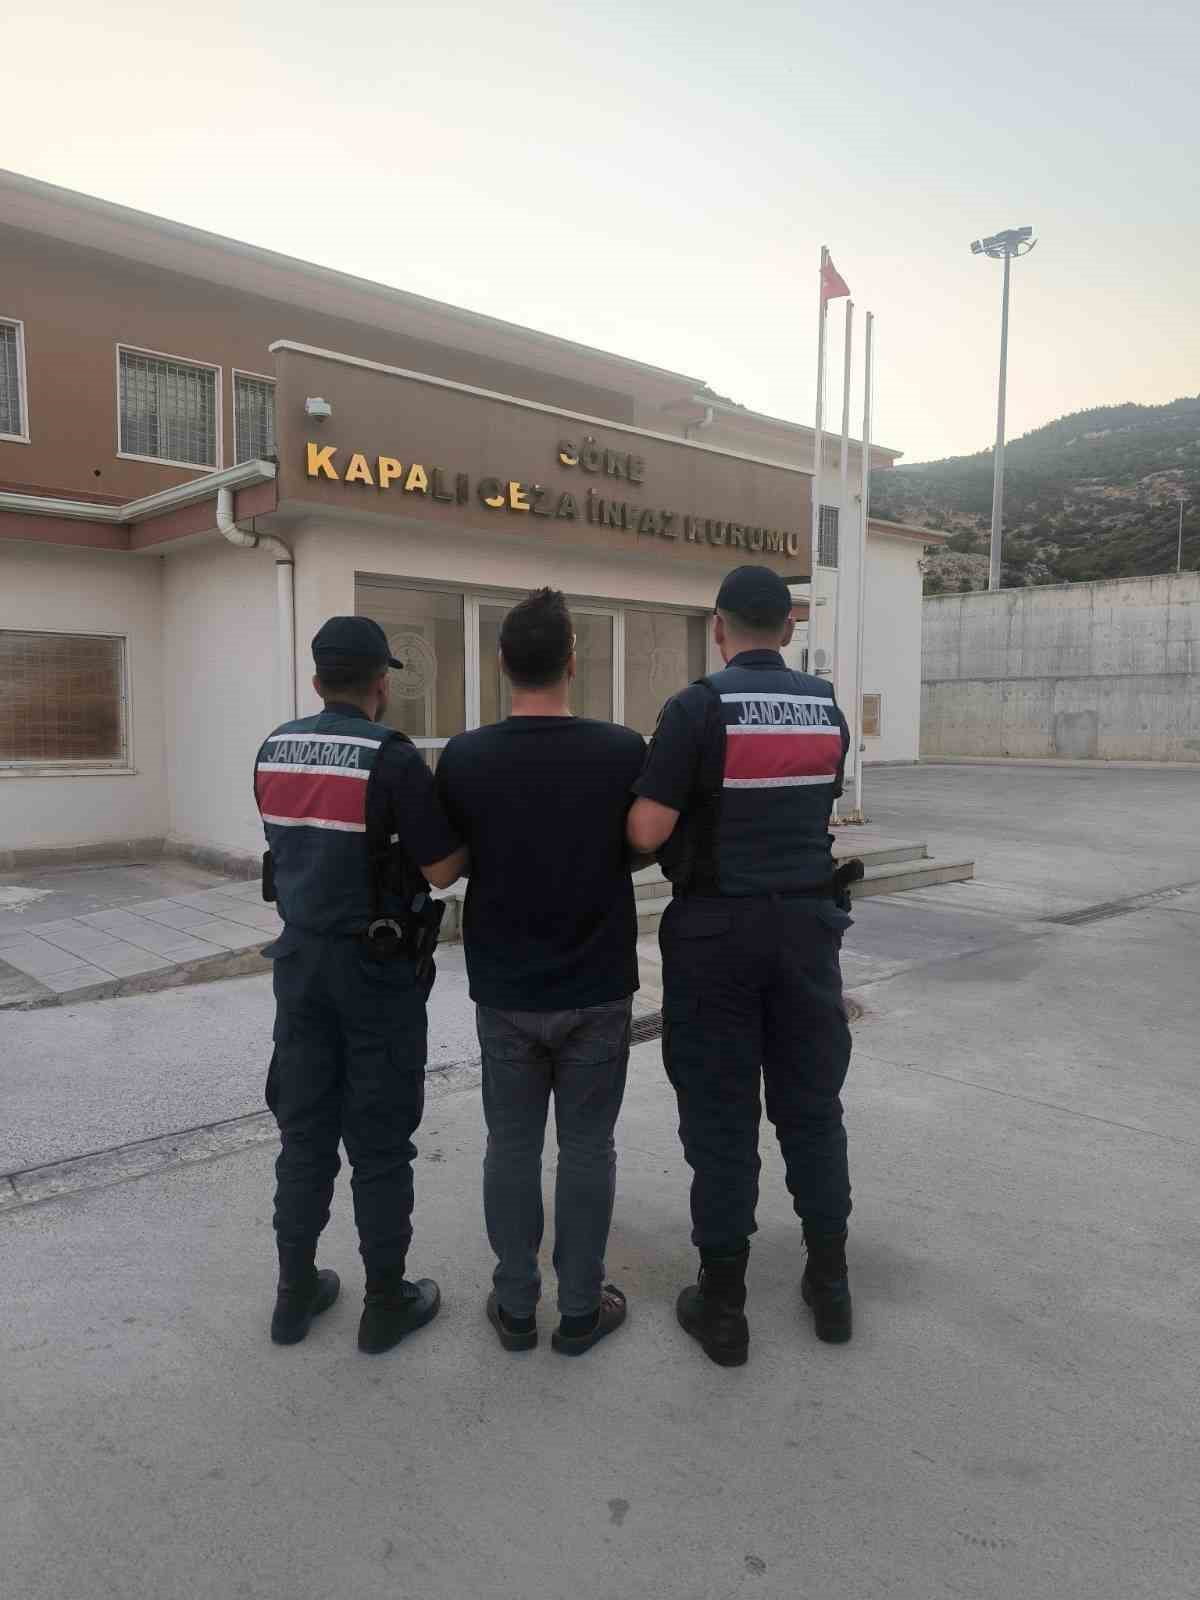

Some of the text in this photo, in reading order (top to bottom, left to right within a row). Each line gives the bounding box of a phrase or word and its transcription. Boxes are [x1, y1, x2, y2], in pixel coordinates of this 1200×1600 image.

[306, 441, 470, 505] KAPALI
[477, 476, 577, 521] CEZA
[738, 701, 832, 726] JANDARMA
[267, 741, 361, 768] JANDARMA
